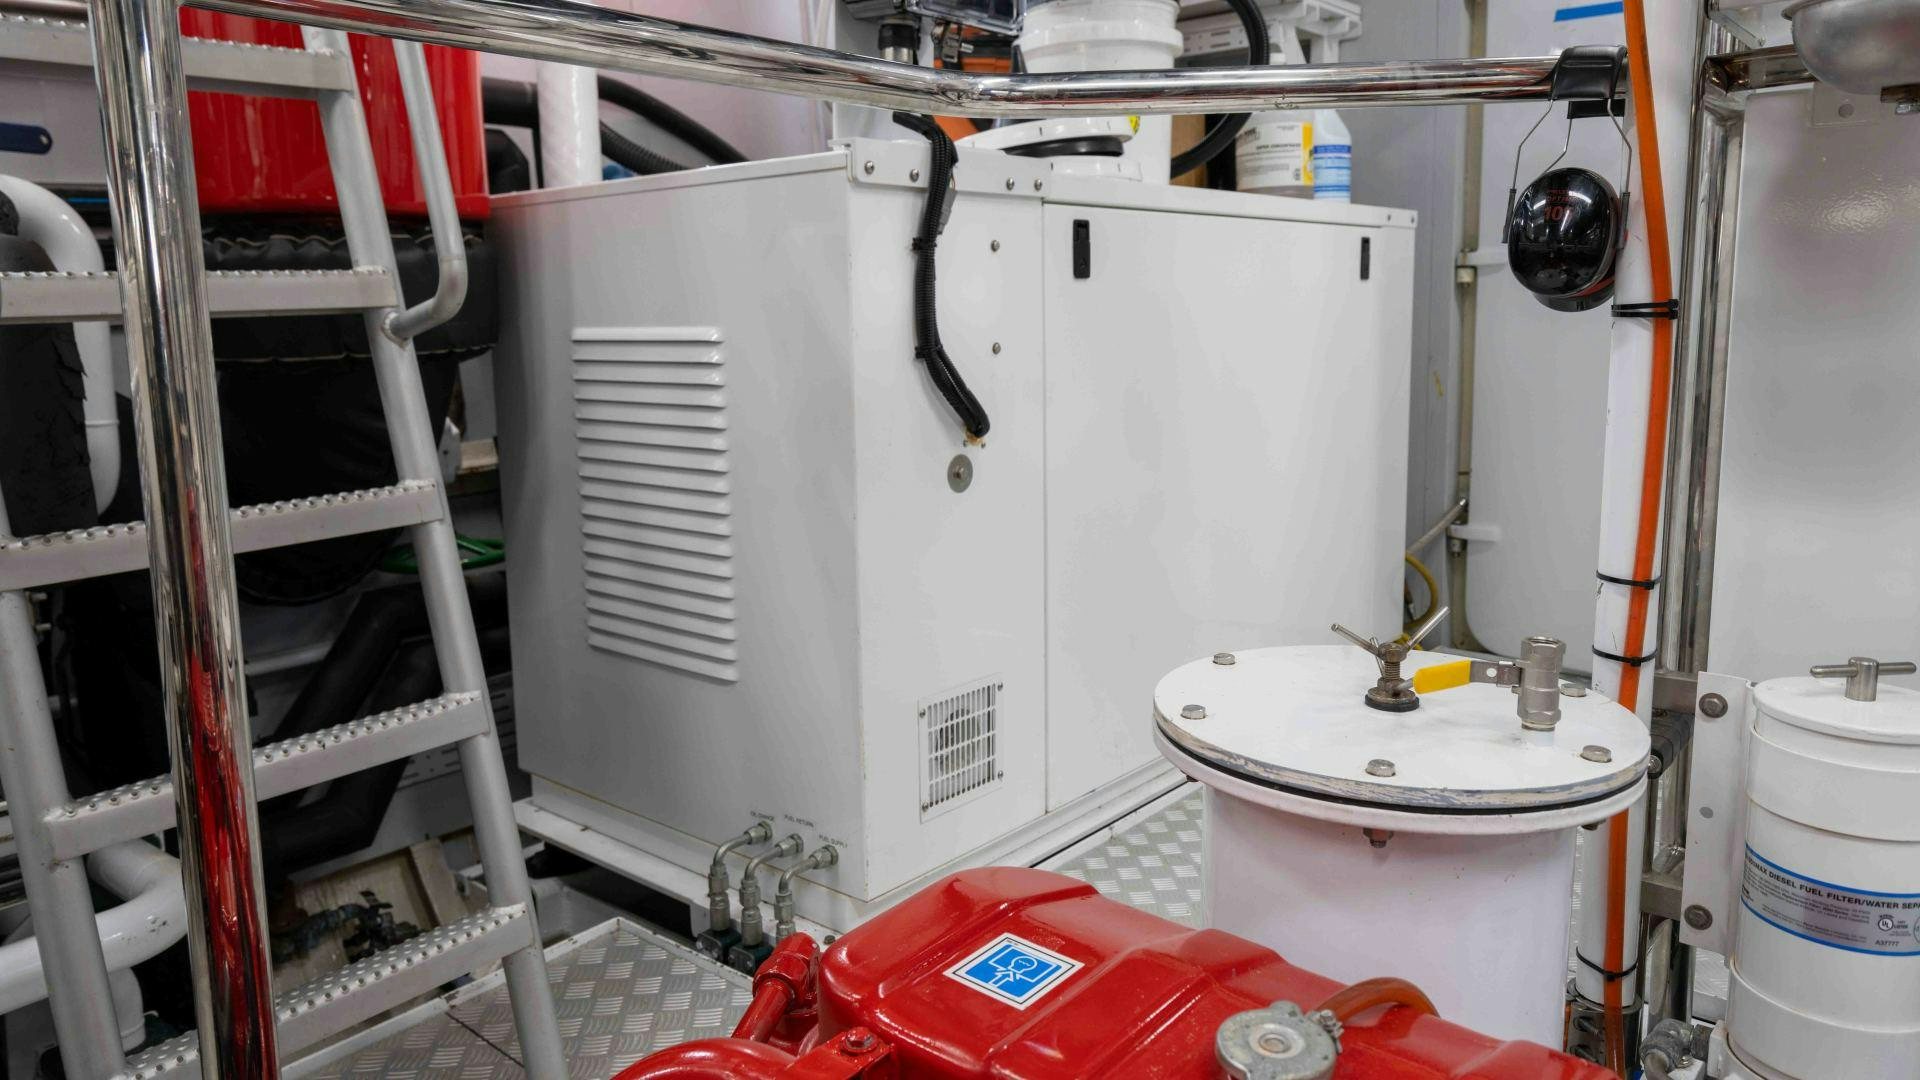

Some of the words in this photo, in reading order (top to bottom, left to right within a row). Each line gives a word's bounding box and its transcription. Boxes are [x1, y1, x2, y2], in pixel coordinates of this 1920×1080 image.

[1768, 871, 1797, 889] DIESEL
[1799, 884, 1824, 897] FUEL
[1826, 893, 1899, 909] FILTER/WATER
